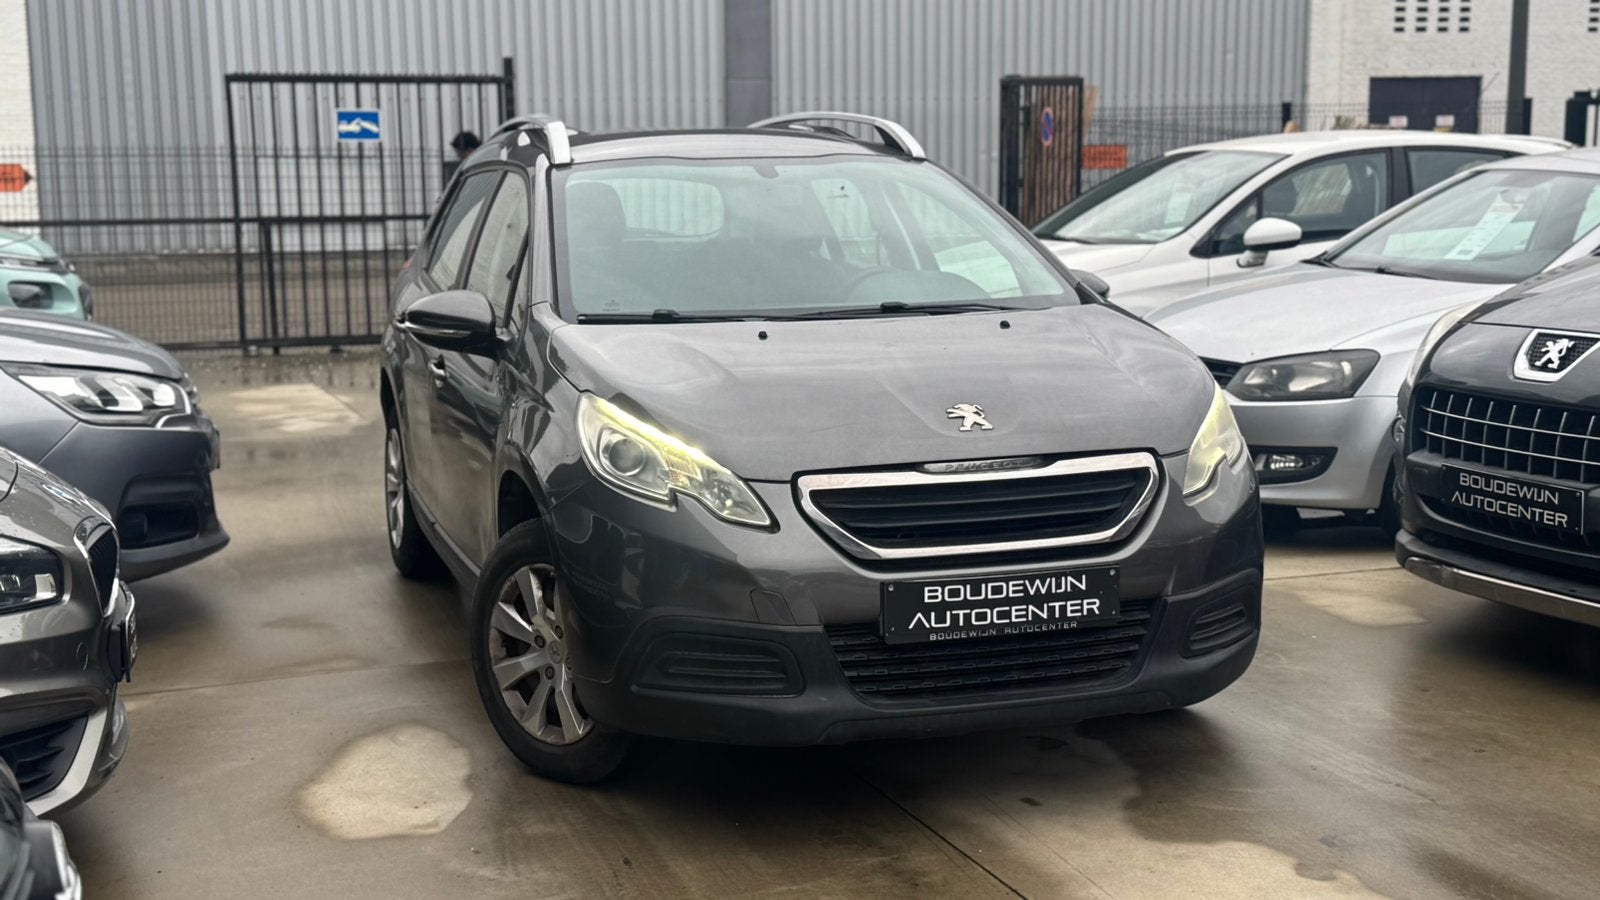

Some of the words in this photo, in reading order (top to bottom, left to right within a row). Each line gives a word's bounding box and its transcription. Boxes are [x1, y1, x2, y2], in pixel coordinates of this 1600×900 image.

[1460, 472, 1559, 505] BOUDEWIJN
[1451, 491, 1568, 528] AUTOCENTER
[923, 574, 1086, 603] BOUDEWIJN
[908, 598, 1100, 629] AUTOCENTER
[929, 629, 997, 641] BOUDEWIJN
[1004, 621, 1078, 635] AUTOCENTER
